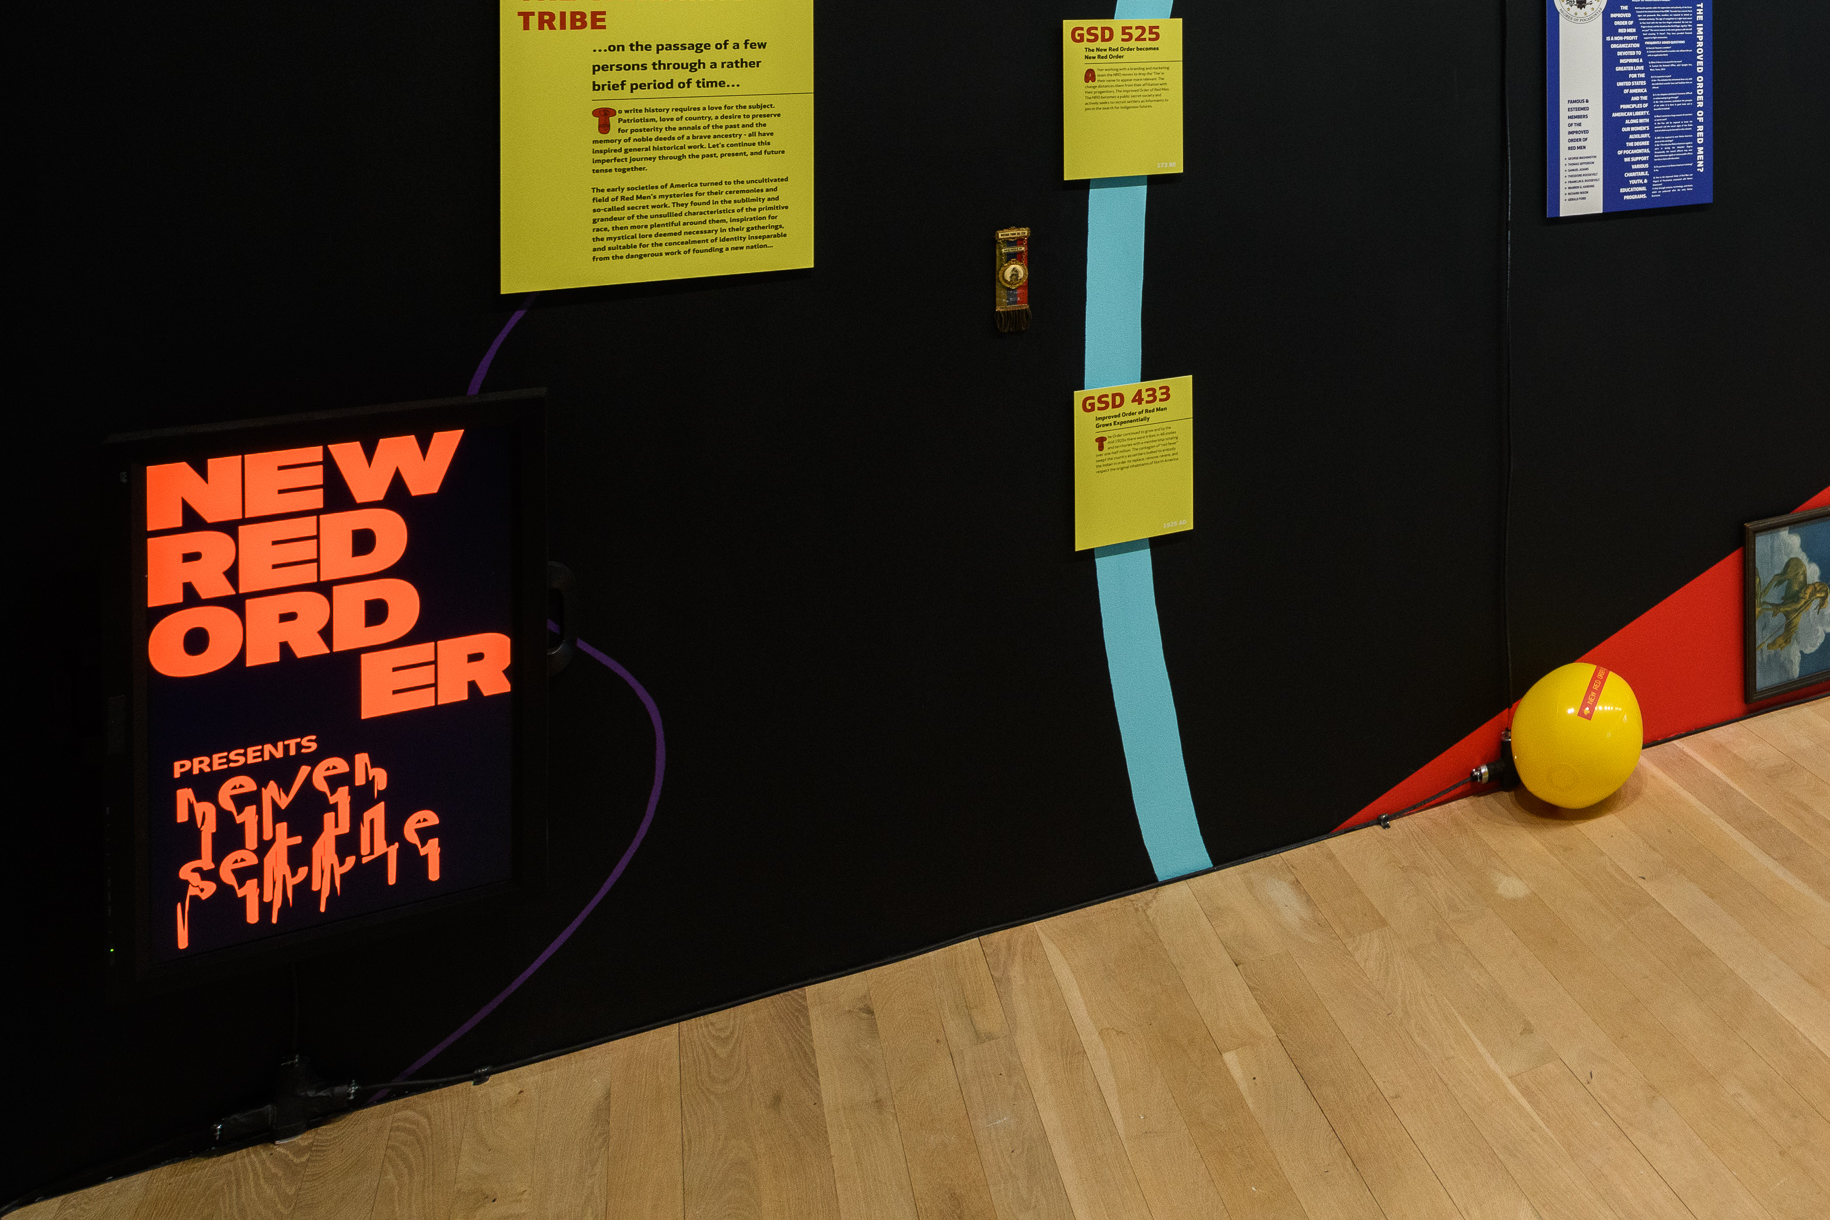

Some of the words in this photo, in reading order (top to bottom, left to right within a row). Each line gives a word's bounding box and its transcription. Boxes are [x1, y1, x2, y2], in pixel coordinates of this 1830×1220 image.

[518, 11, 606, 30] TRIBE
[1696, 3, 1704, 21] THE
[1071, 26, 1114, 43] GSD
[1121, 26, 1160, 42] 525
[629, 41, 652, 51] the
[656, 43, 711, 54] passage
[715, 40, 729, 50] of
[744, 39, 767, 49] few
[1696, 24, 1704, 73] IMPROVED
[592, 64, 647, 75] persons
[652, 59, 706, 72] through
[721, 58, 762, 68] rather
[592, 80, 626, 91] brief
[630, 79, 673, 93] period
[678, 78, 692, 88] of
[1696, 76, 1704, 107] ORDER
[1696, 110, 1704, 122] OF
[1696, 126, 1704, 144] RED
[1696, 147, 1704, 172] MEN?
[1082, 392, 1124, 412] GSD
[1131, 386, 1170, 405] 433
[1096, 413, 1120, 421] Improved
[1113, 416, 1150, 426] Exponentially
[146, 429, 464, 531] NEW
[147, 508, 408, 608] RED
[148, 578, 420, 678] ORD
[360, 632, 511, 719] ER
[1588, 692, 1596, 705] NEW
[173, 735, 318, 778] PRESENTS
